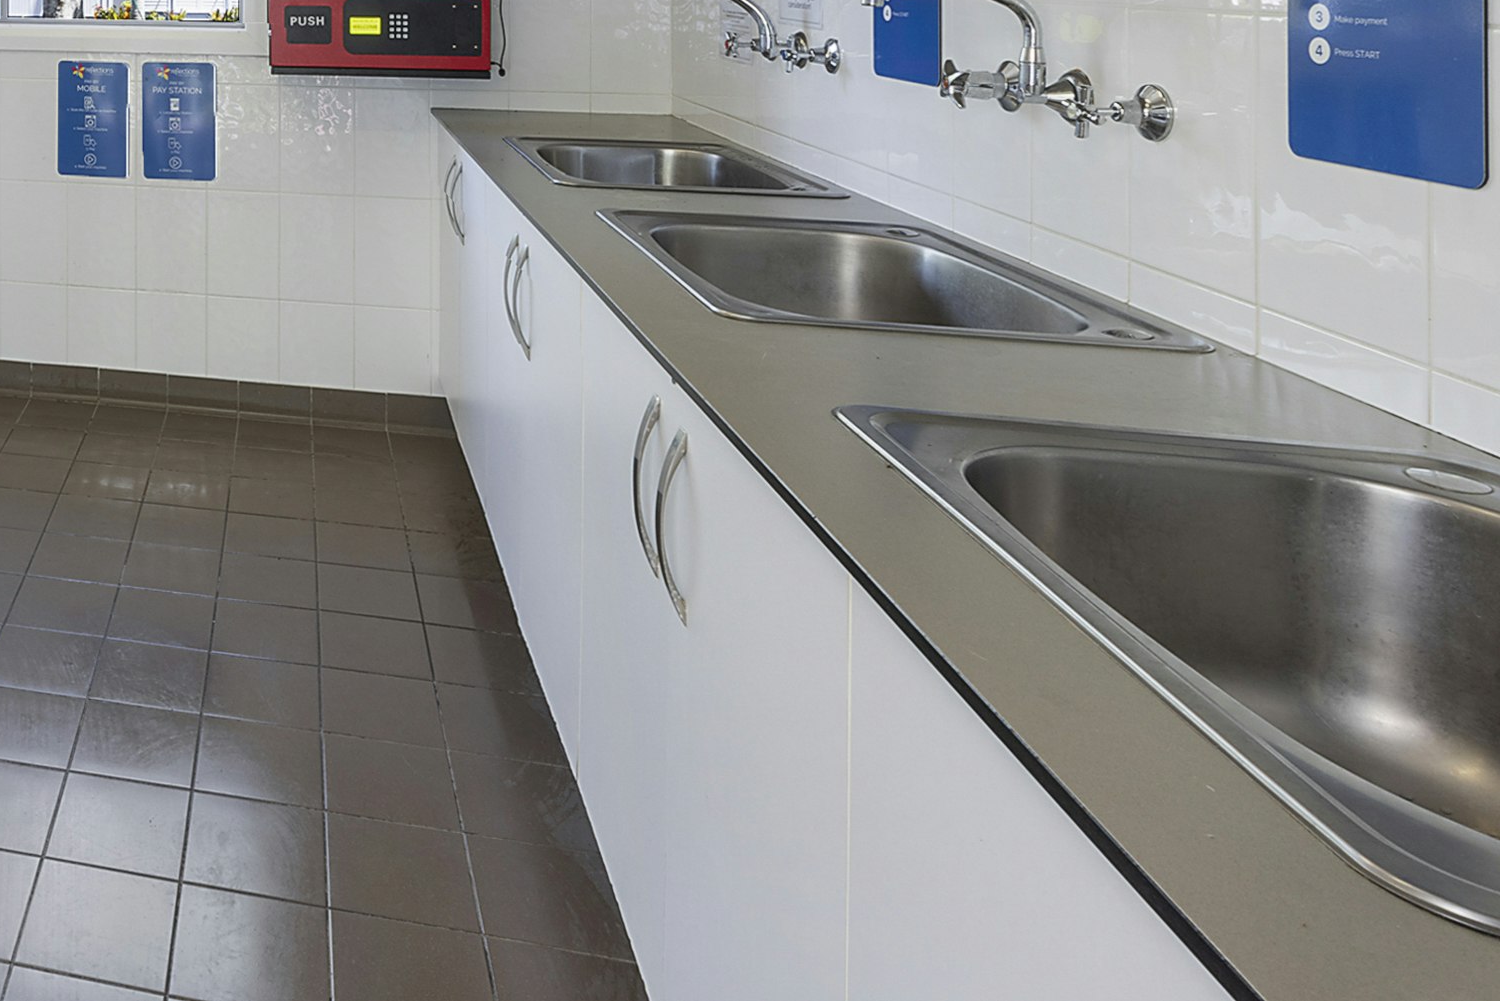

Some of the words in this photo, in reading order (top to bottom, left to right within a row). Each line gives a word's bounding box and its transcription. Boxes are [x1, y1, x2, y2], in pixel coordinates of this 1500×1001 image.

[290, 16, 325, 26] PUSH
[1315, 11, 1323, 23] 3
[1334, 15, 1353, 24] Make
[1355, 17, 1388, 26] payment
[1315, 44, 1323, 56] 4
[1334, 48, 1354, 57] Press
[1355, 49, 1380, 59] START
[77, 84, 107, 93] MOBILE
[168, 86, 203, 95] STATION
